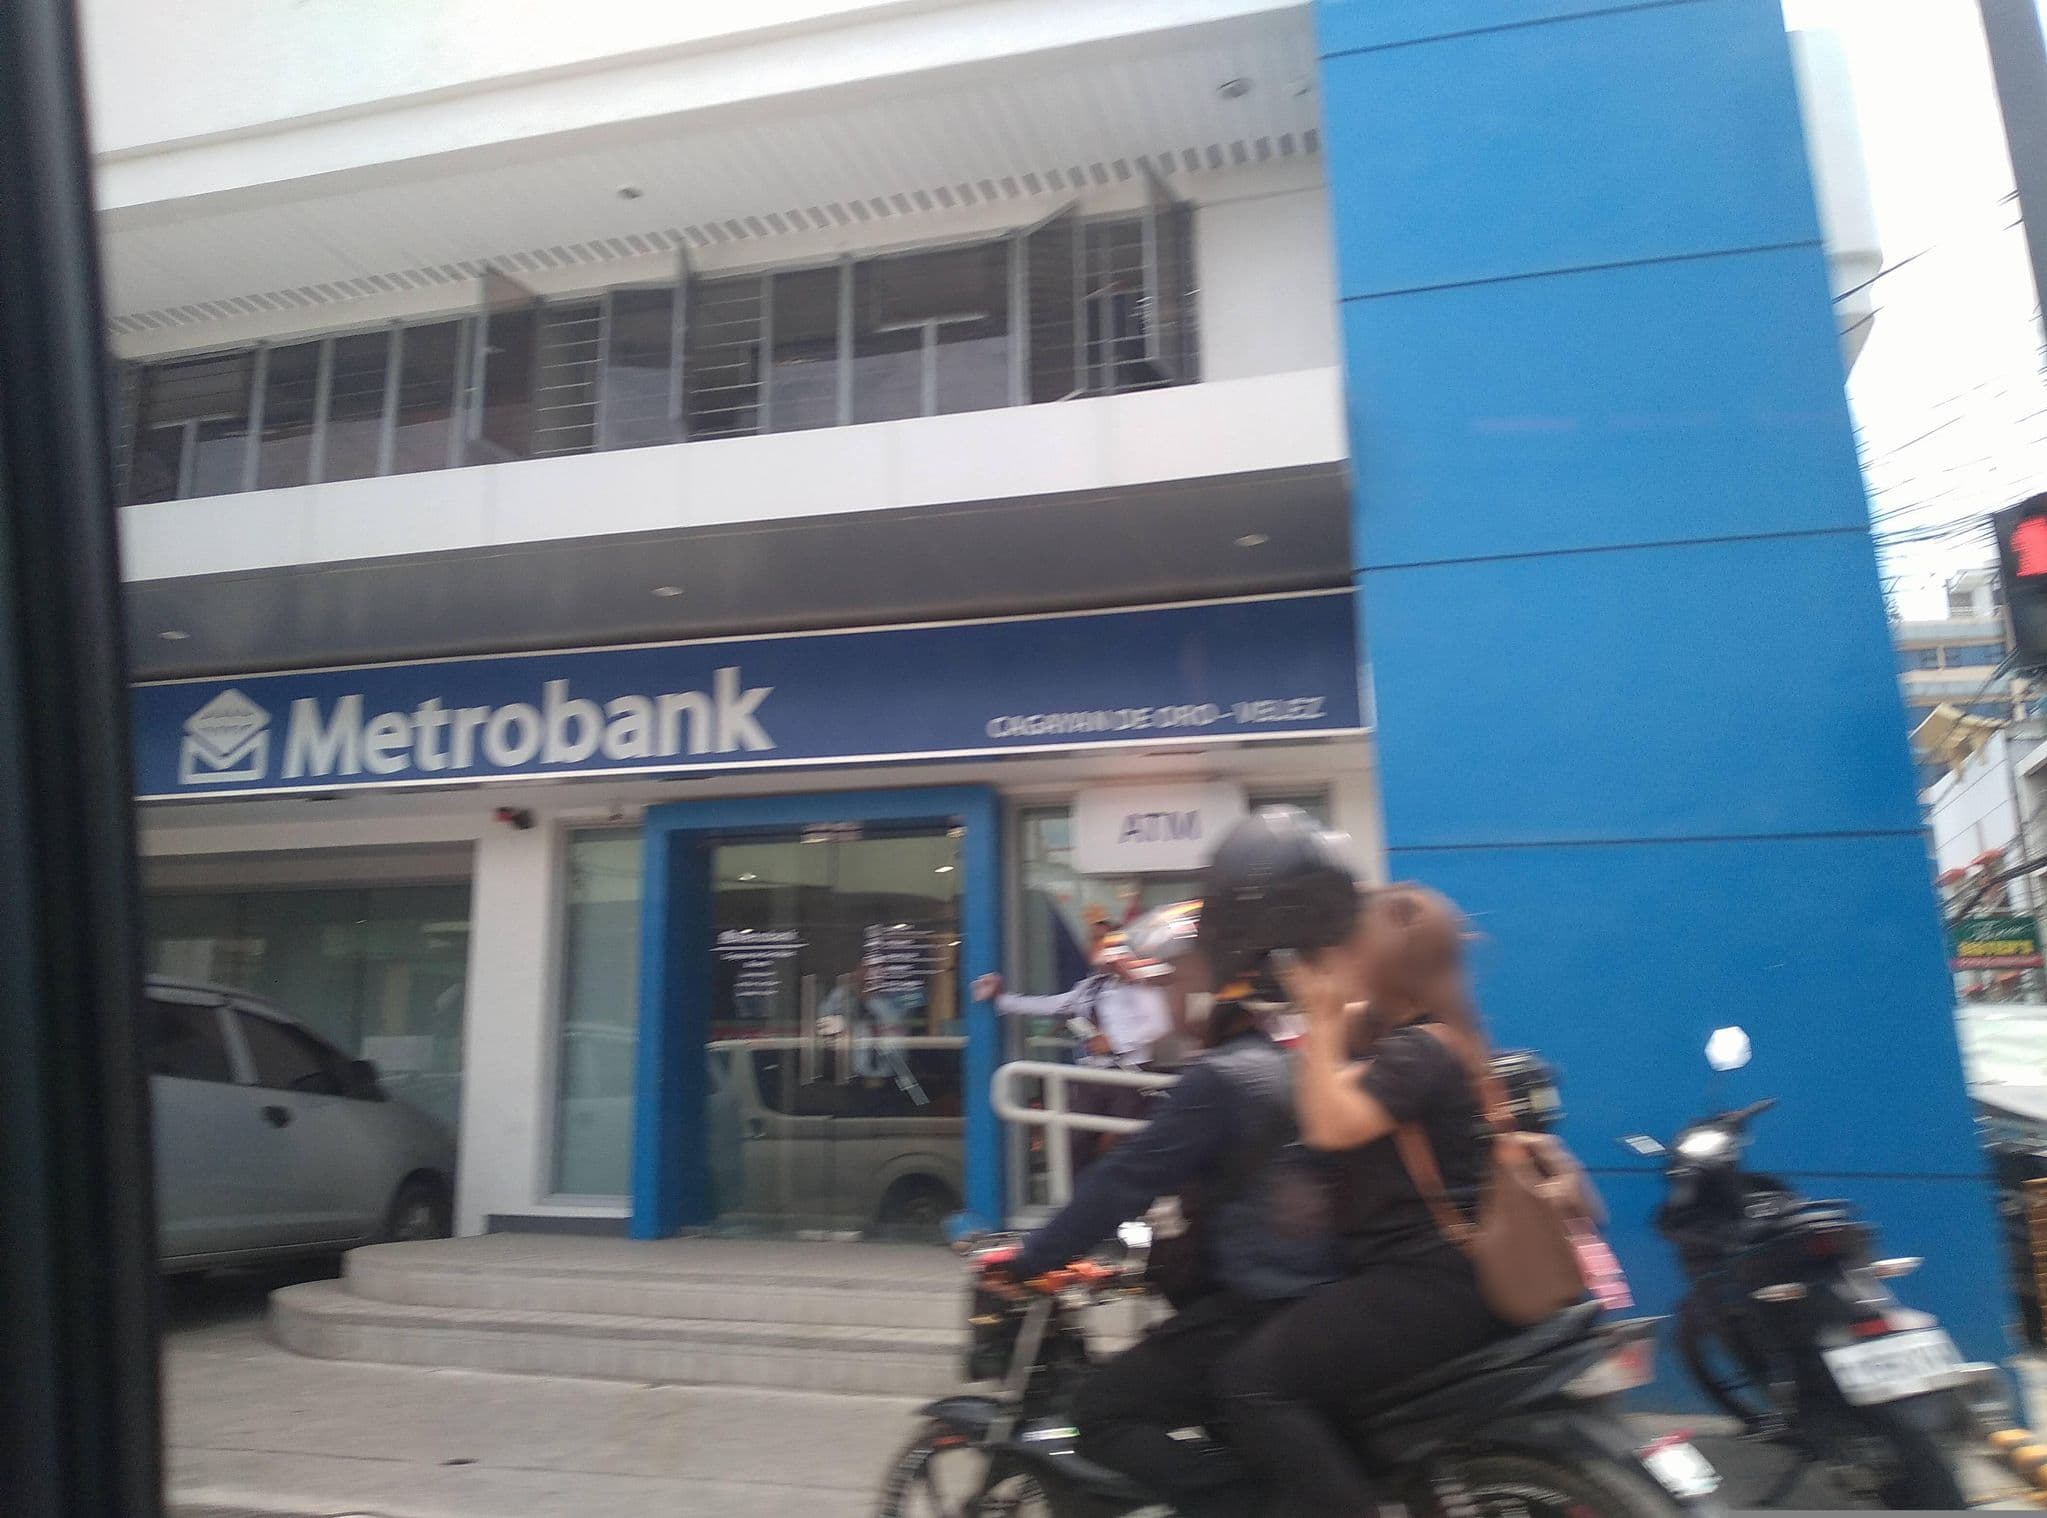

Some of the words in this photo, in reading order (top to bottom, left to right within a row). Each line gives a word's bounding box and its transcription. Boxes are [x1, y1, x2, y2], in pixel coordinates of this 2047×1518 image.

[281, 666, 776, 779] Metrobank
[1111, 707, 1153, 731] DE
[1152, 703, 1220, 728] ORO
[1231, 696, 1326, 724] VELEZ
[1119, 810, 1202, 844] ATM
